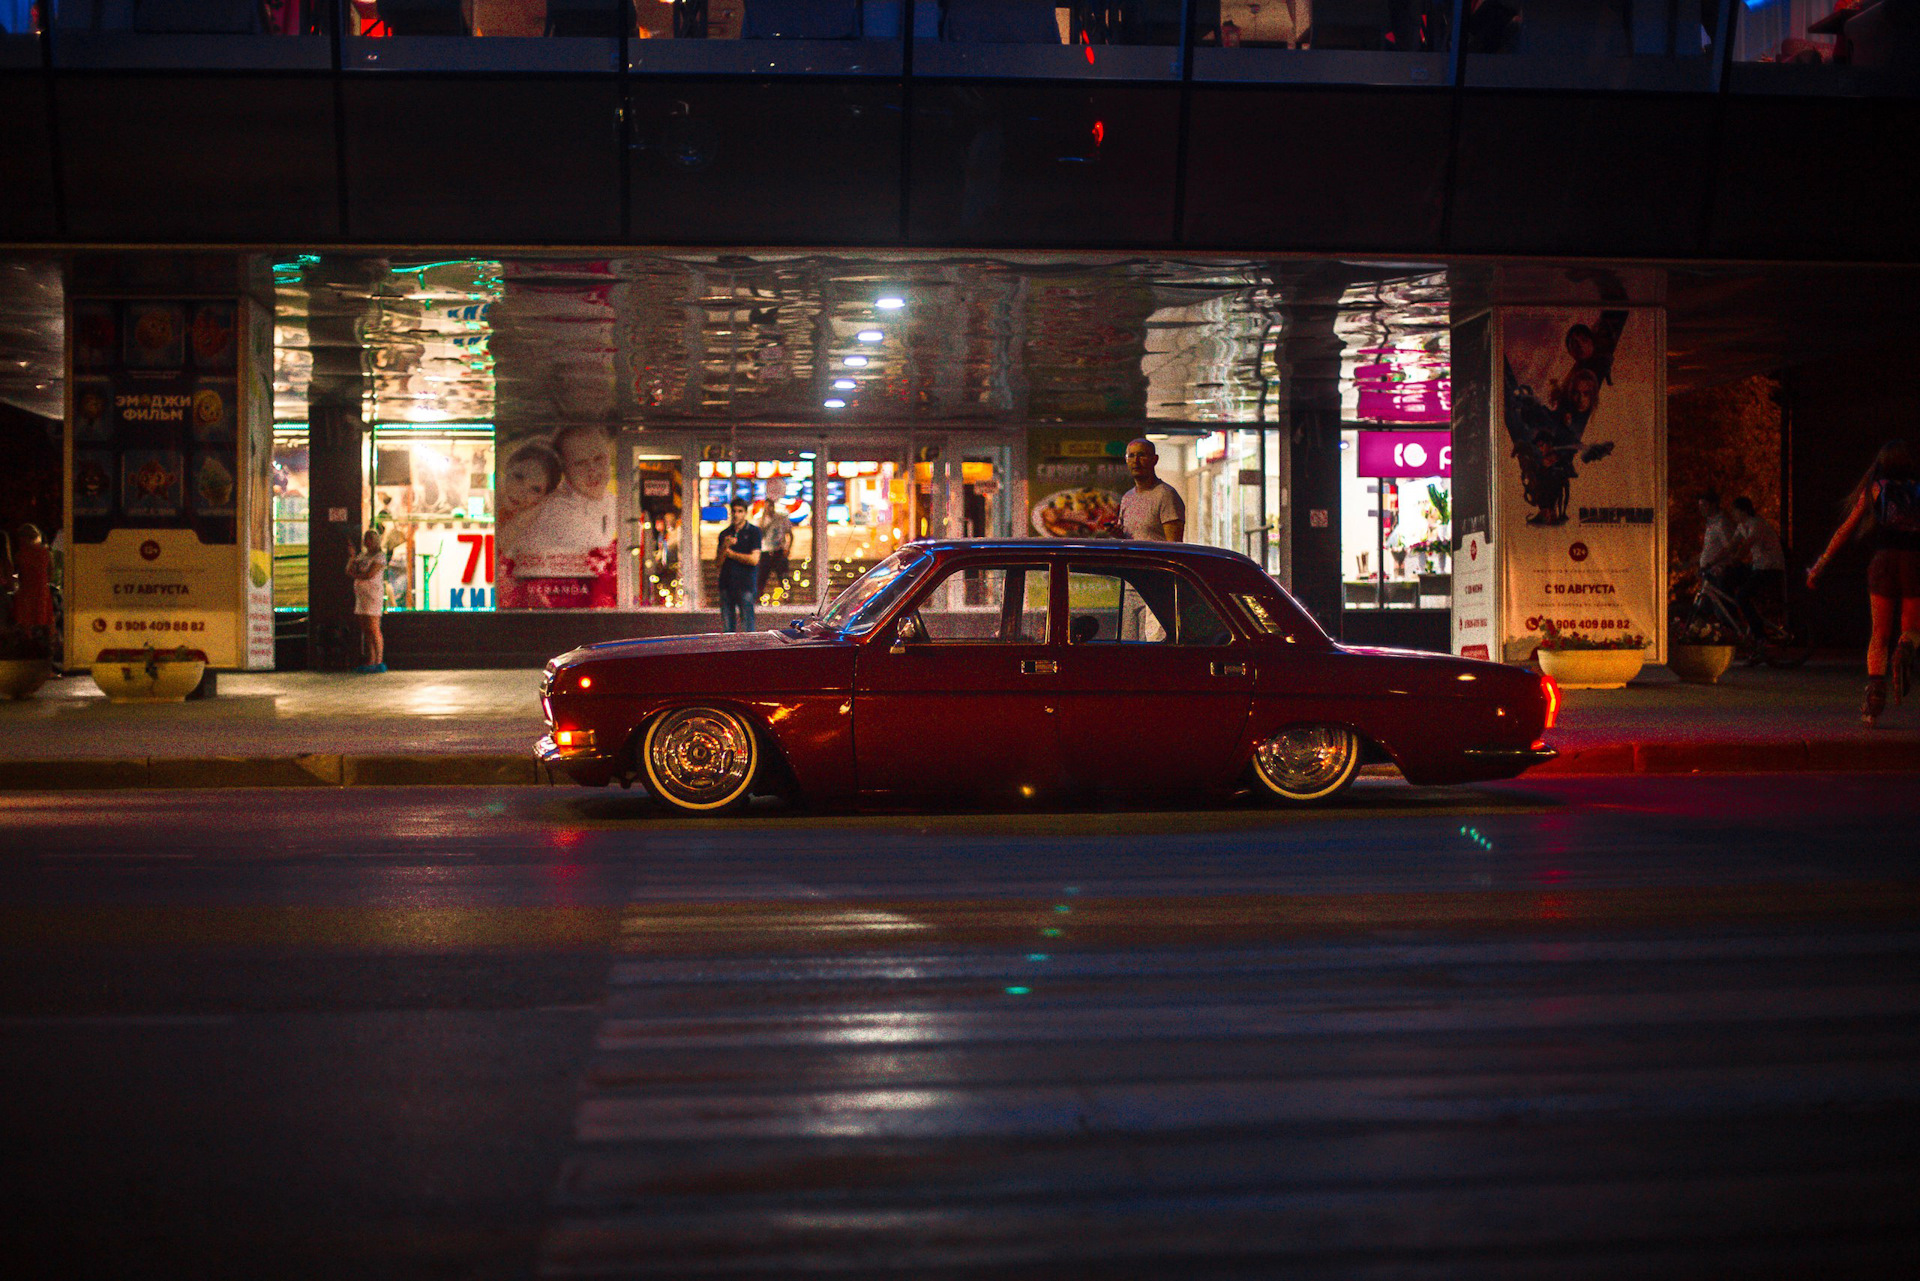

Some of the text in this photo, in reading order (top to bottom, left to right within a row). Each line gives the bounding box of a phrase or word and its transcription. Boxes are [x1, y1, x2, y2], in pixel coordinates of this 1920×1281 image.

[122, 408, 184, 421] ФИЛЬМ
[137, 584, 189, 595] АВГУСТА
[1544, 584, 1616, 594] С 10 АВГУСТА
[149, 621, 171, 632] 409
[173, 621, 188, 632] 88
[190, 621, 205, 632] 82
[1556, 619, 1630, 629] 906 409 88 82
